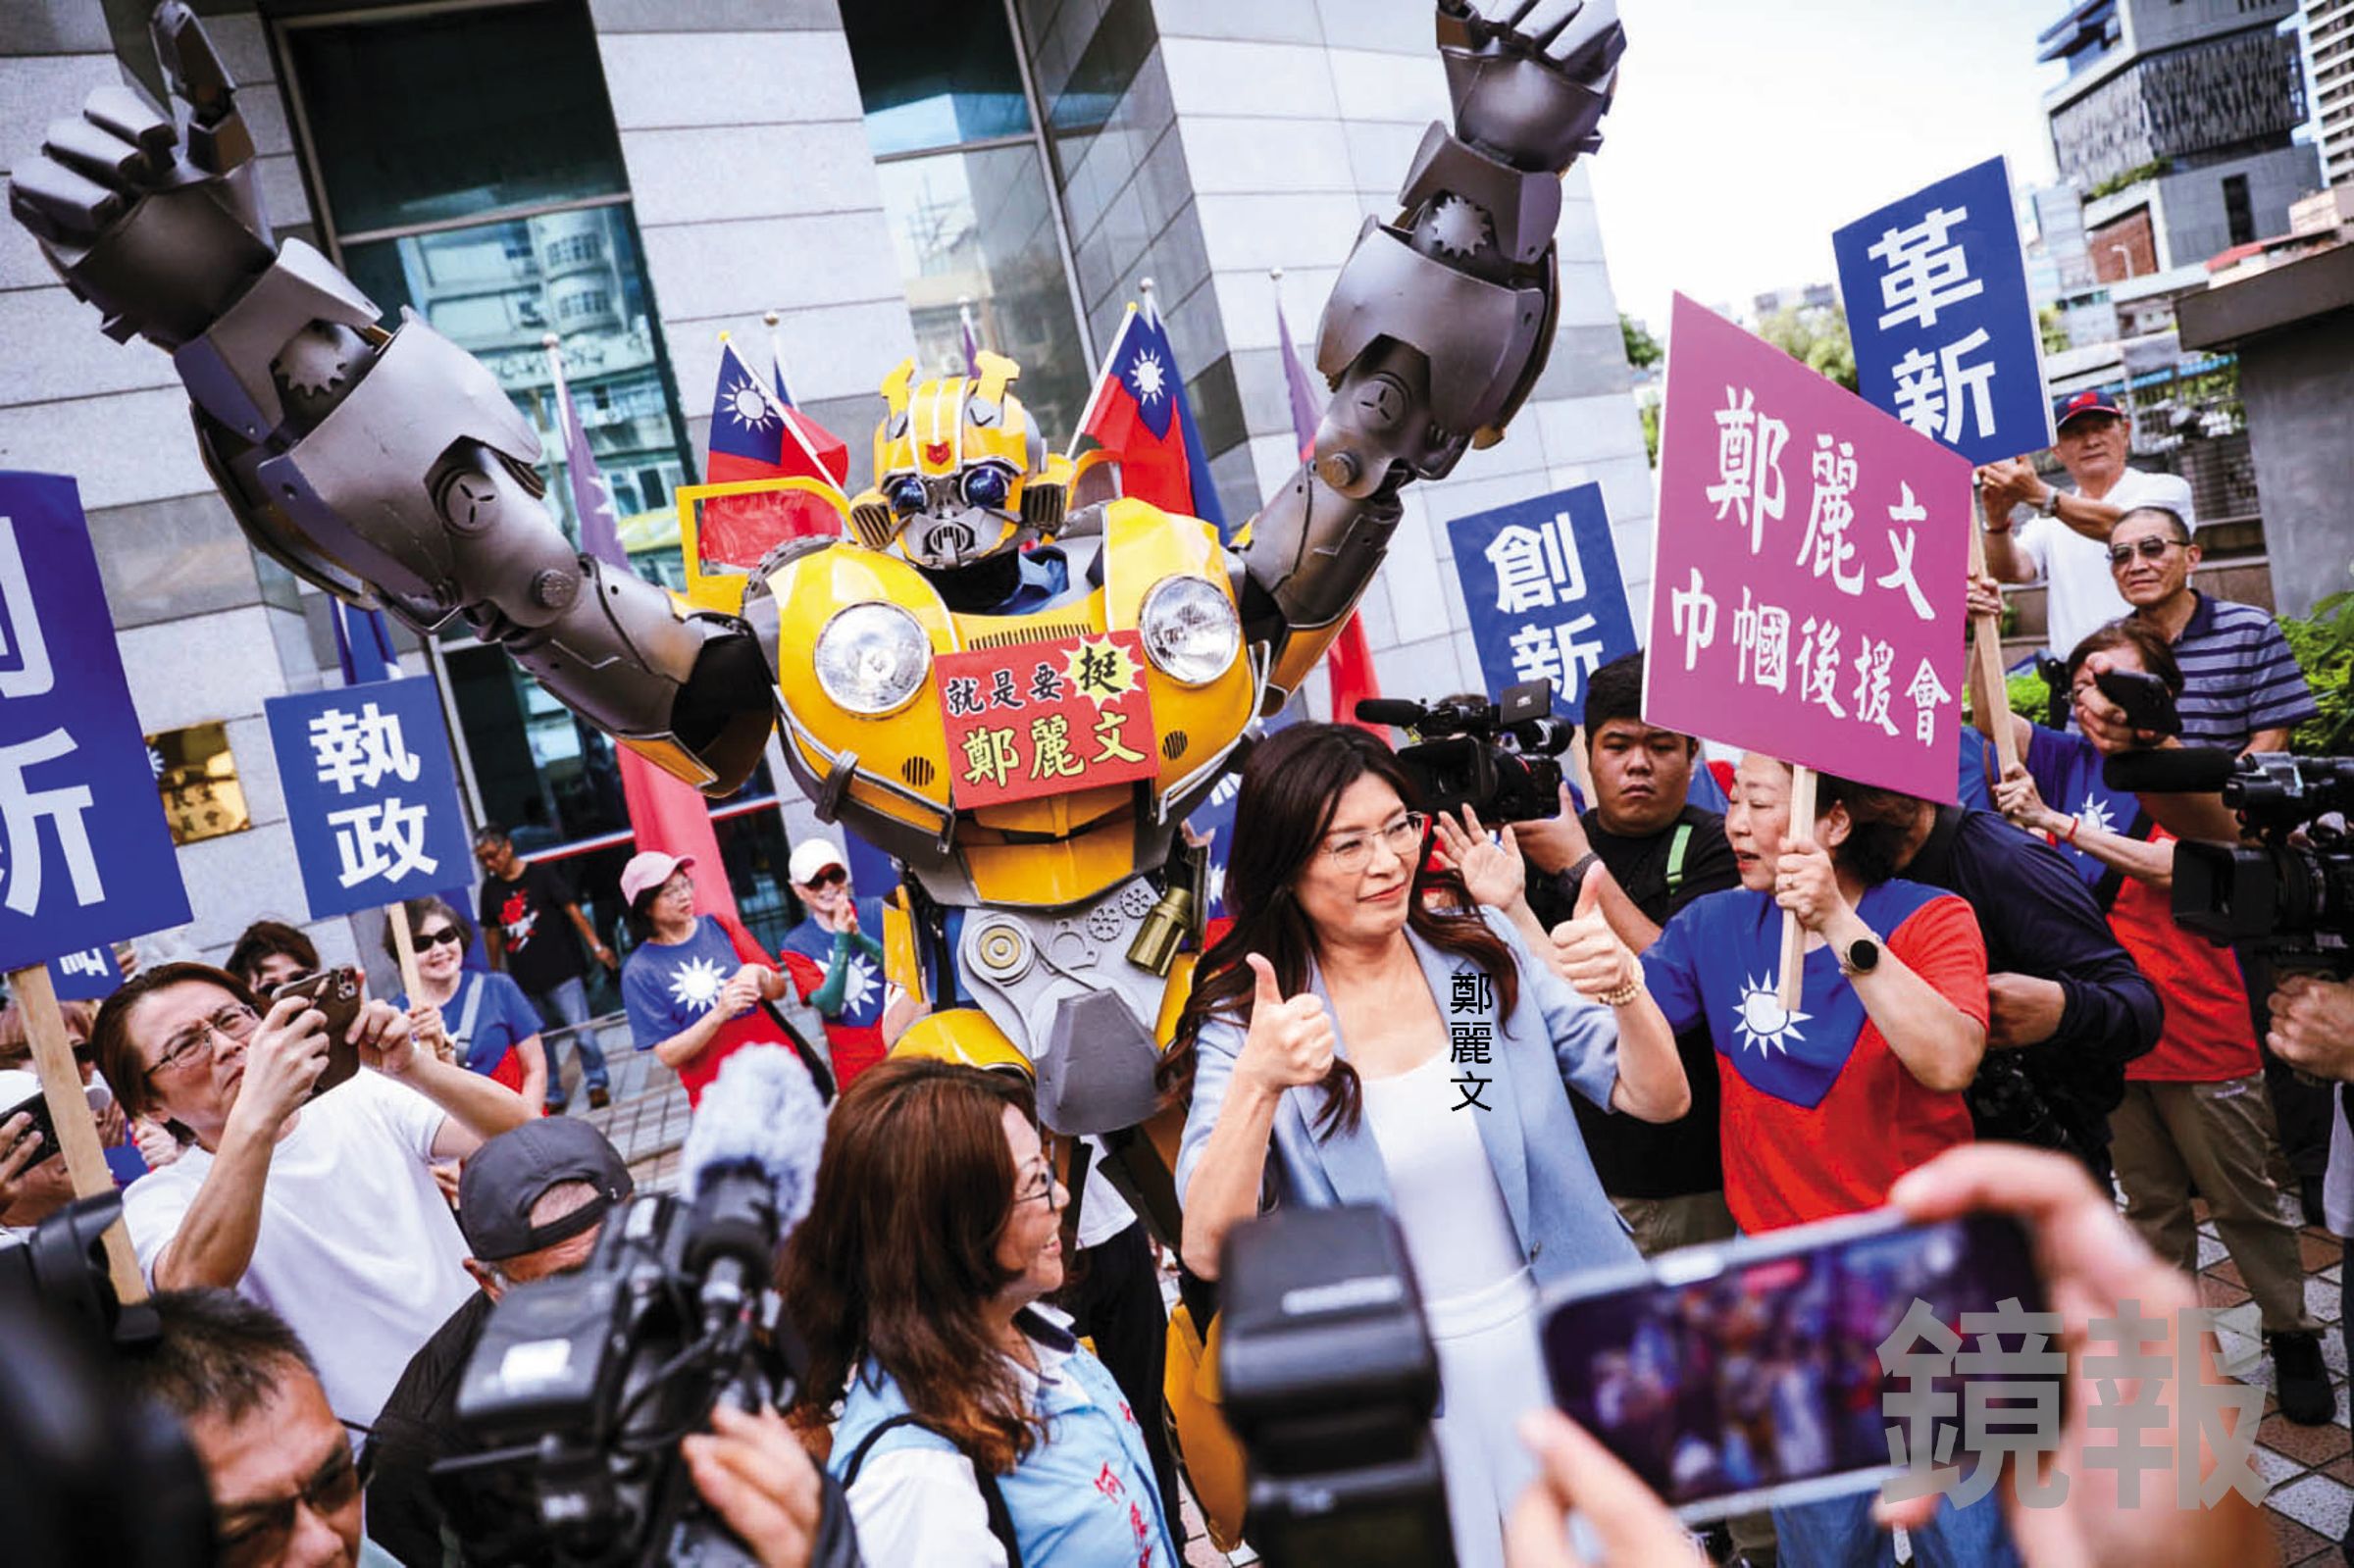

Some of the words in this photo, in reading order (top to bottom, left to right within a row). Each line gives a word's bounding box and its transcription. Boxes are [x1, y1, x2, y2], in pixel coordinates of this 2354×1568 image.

[1867, 205, 1996, 444] 革新
[1706, 383, 1936, 621] 鄭麗文
[1483, 511, 1604, 704] 創新
[1670, 566, 1952, 747] 巾幗後援會
[308, 702, 439, 888] 執政
[961, 710, 1146, 787] 鄭麗文
